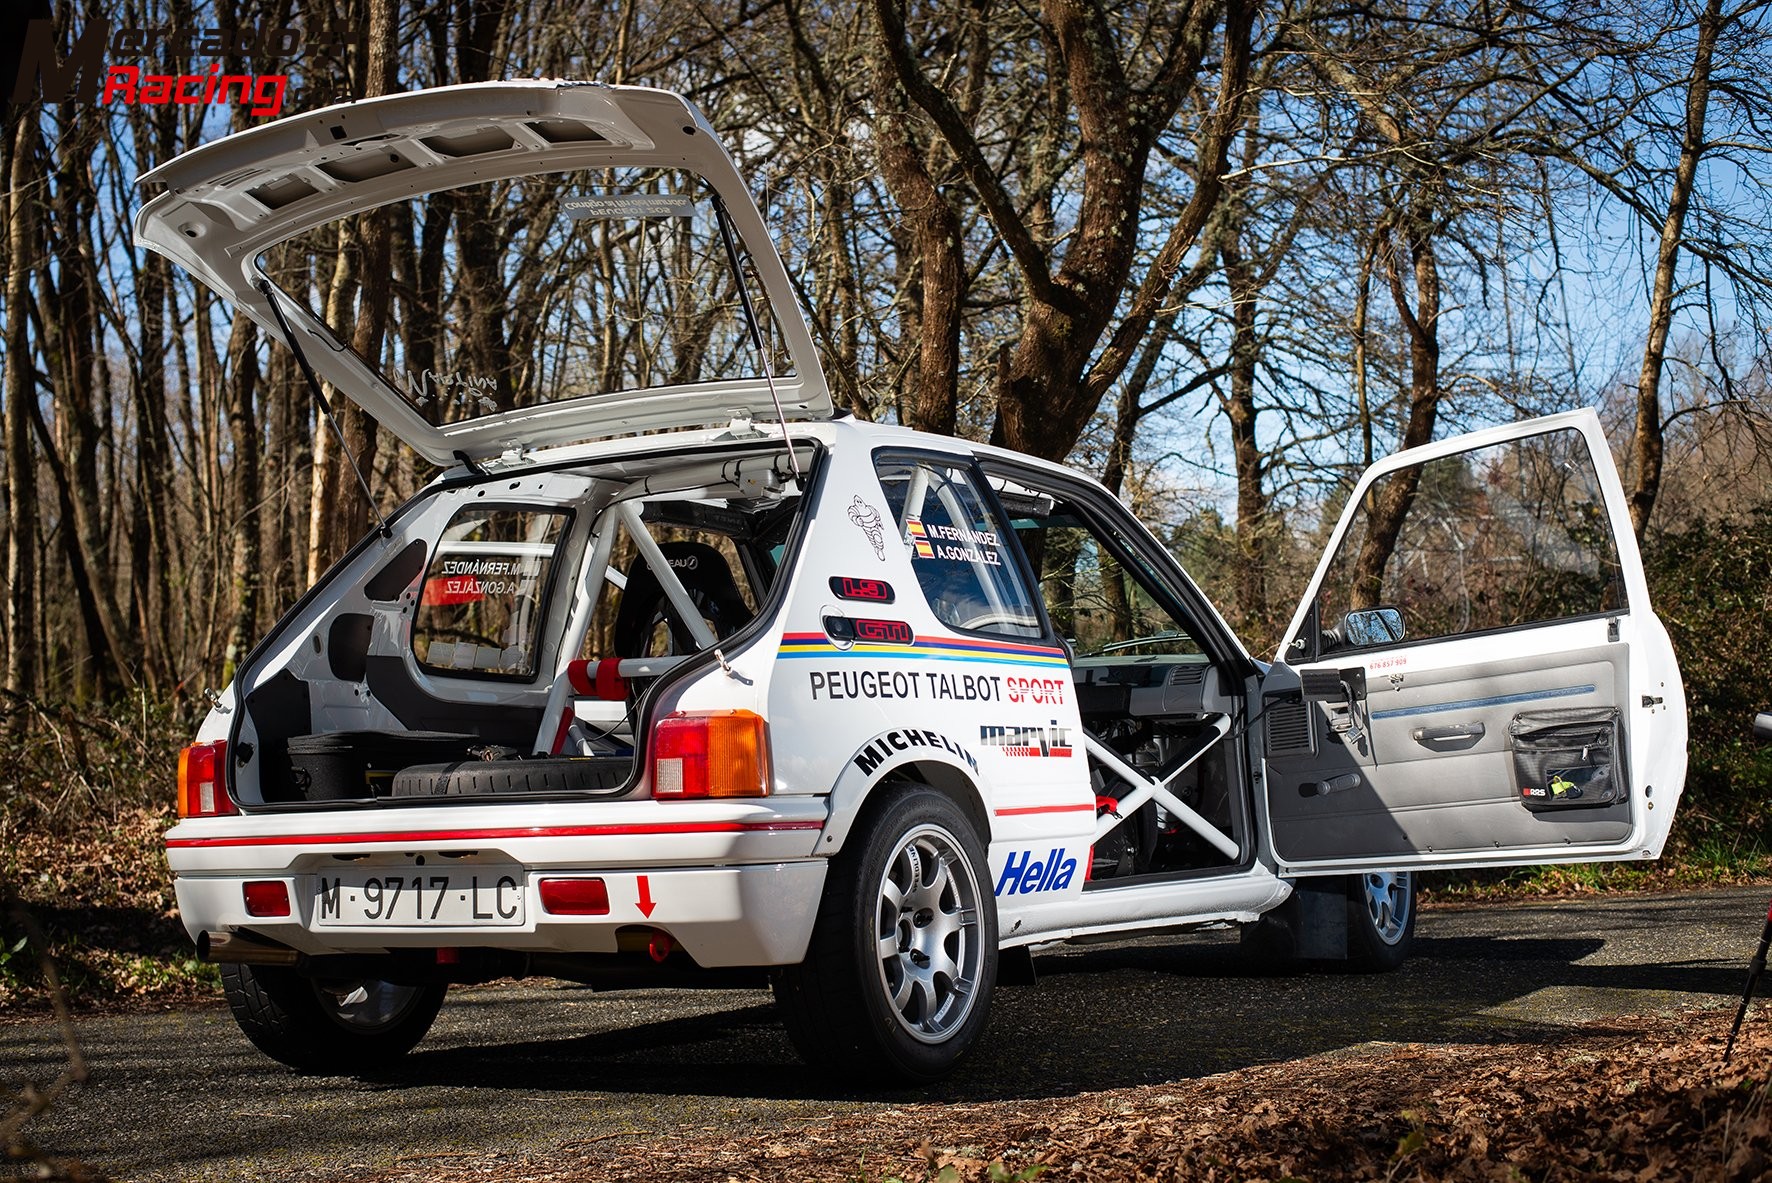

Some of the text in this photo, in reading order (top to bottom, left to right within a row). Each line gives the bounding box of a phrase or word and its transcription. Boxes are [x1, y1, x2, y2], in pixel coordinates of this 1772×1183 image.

[809, 671, 1064, 705] PEUGEOT TALBOT SPORT
[853, 728, 980, 777] MICHELIN
[995, 847, 1078, 897] Hella
